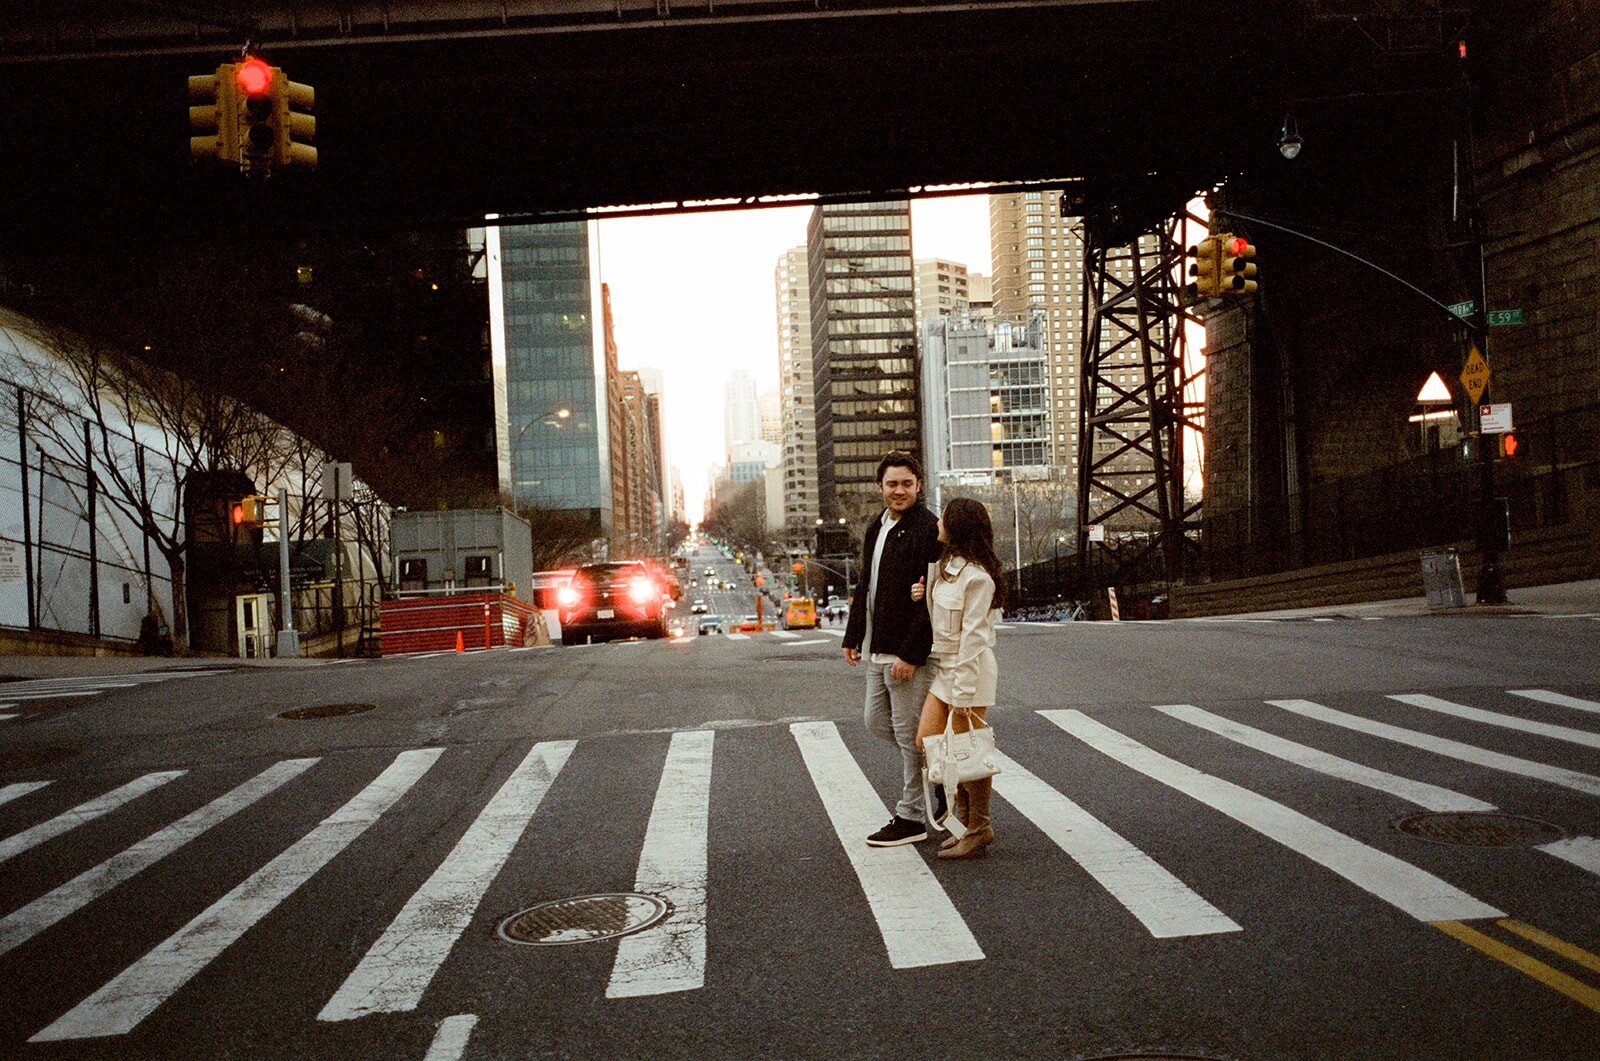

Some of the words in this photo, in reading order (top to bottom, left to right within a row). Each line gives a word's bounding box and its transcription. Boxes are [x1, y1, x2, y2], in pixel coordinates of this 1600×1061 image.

[1489, 314, 1495, 324] E
[1499, 312, 1511, 323] 59
[1466, 362, 1483, 375] DEAD
[1469, 379, 1482, 390] END
